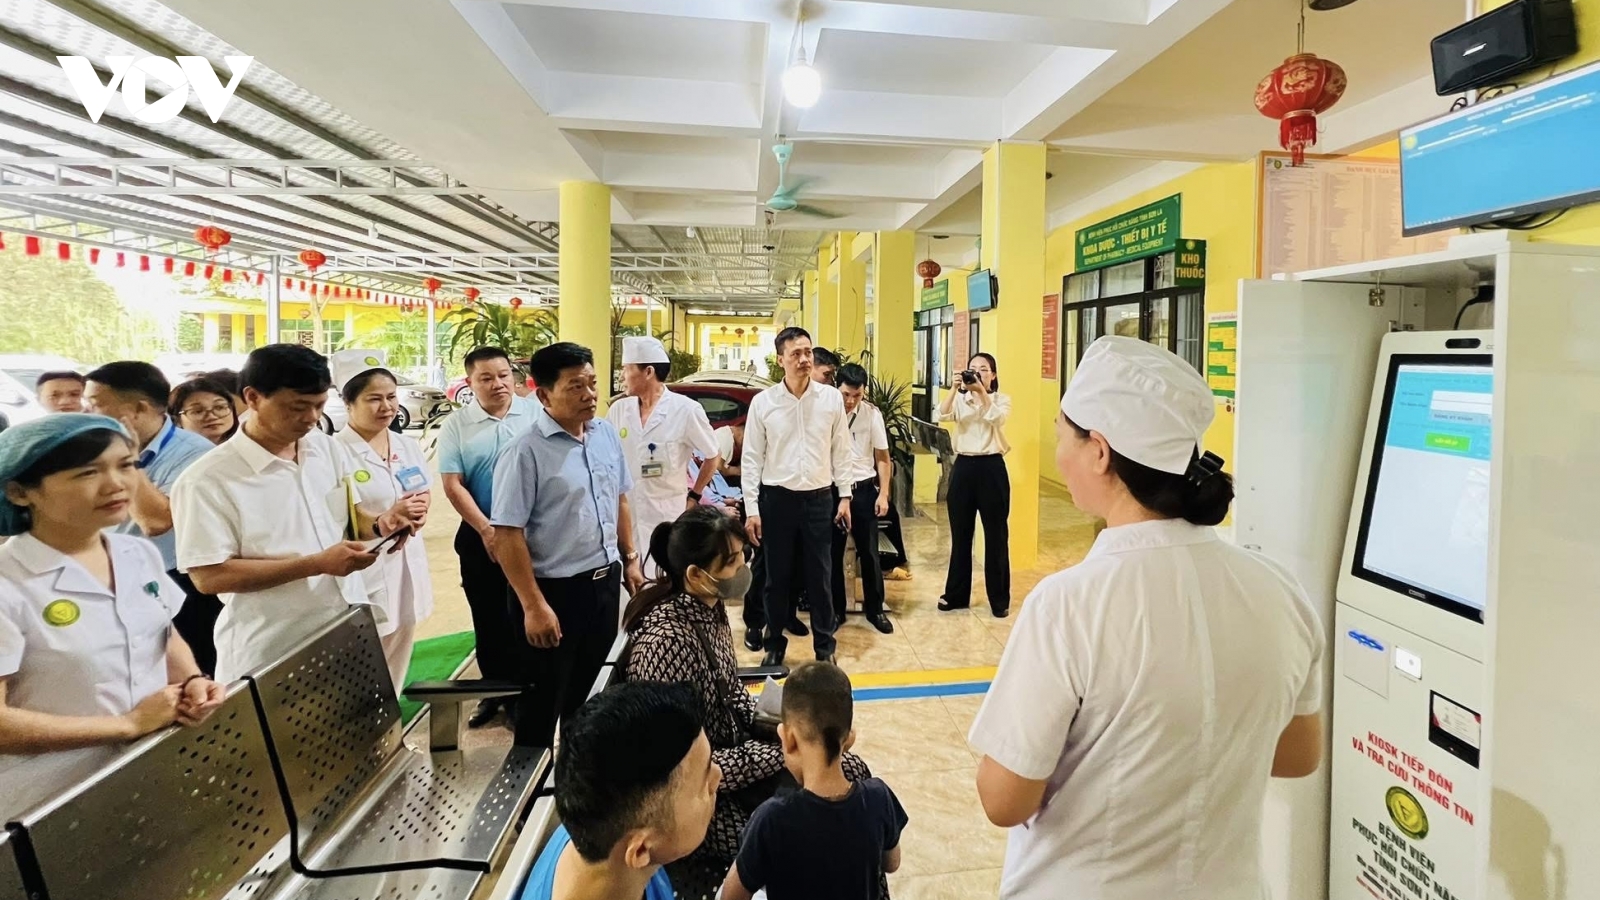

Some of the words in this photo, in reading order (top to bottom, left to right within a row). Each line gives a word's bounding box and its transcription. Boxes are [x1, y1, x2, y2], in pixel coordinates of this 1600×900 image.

[1082, 243, 1098, 256] KHOA
[1121, 227, 1140, 246] THIẾT
[1140, 227, 1149, 241] BỊ
[1150, 225, 1156, 236] Y
[1158, 217, 1168, 235] TẾ
[1181, 253, 1200, 264] KHO
[1176, 264, 1205, 279] THUỐC
[1366, 746, 1385, 768] TRA
[1412, 775, 1450, 810] THÔNG
[1453, 802, 1474, 826] TIN
[1368, 730, 1398, 759] KIOSK
[1401, 751, 1425, 773] TIẾP
[1428, 768, 1453, 794] ĐÓN
[1352, 817, 1378, 846] PHỤC
[1380, 840, 1398, 862] HỒI
[1400, 856, 1430, 888] CHỨC
[1378, 821, 1406, 852] BỆNH
[1409, 844, 1436, 874] VIỆN
[1373, 850, 1396, 878] TỈNH
[1400, 872, 1422, 900] SƠN
